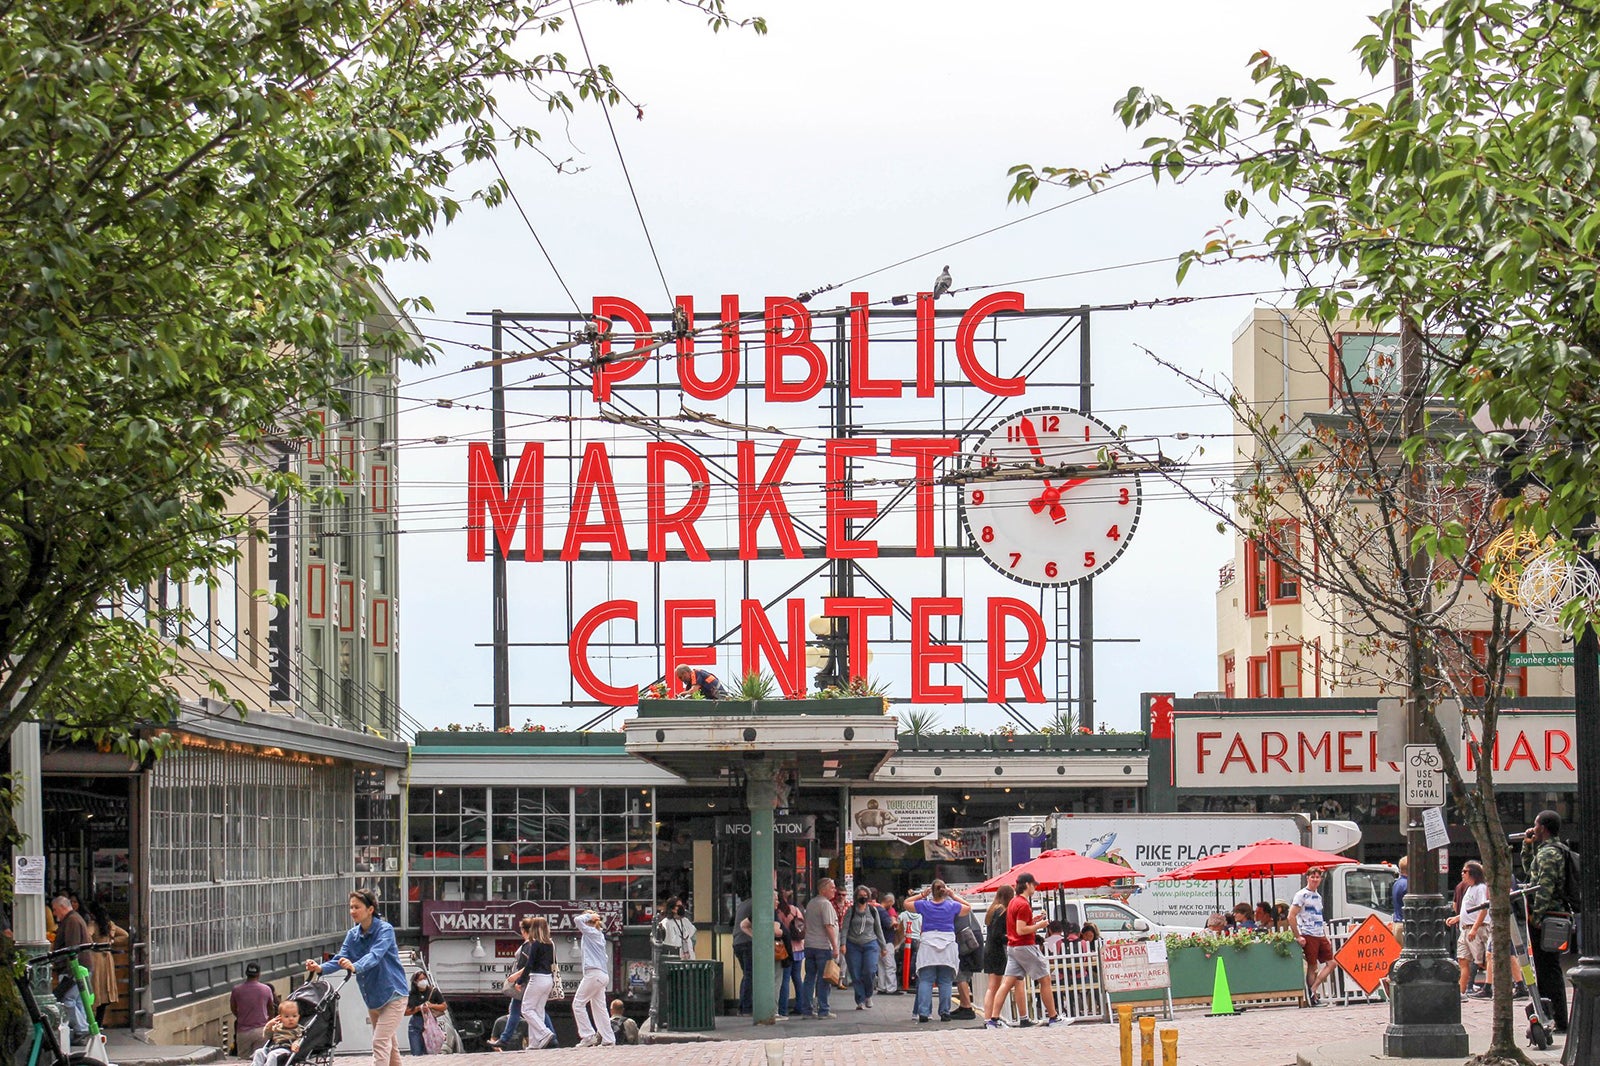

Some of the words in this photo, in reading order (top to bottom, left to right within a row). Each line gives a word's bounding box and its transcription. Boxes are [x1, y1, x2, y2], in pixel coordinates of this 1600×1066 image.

[592, 291, 1027, 403] PUBLIC
[1041, 415, 1060, 433] 12
[1007, 425, 1021, 443] 11
[1084, 425, 1090, 442] 1
[467, 437, 960, 562] MARKET
[971, 489, 985, 506] 9
[1118, 487, 1129, 505] 3
[981, 525, 995, 543] 8
[1106, 524, 1121, 541] 4
[1009, 552, 1022, 568] 7
[1083, 551, 1096, 568] 5
[1044, 561, 1058, 578] 6
[568, 596, 1048, 707] CENTER
[1515, 656, 1545, 665] pioneer
[1416, 769, 1432, 778] USE
[1417, 780, 1433, 788] PED
[1410, 789, 1439, 798] SIGNAL
[886, 800, 906, 810] YOUR
[907, 800, 935, 809] CHANGE
[725, 823, 803, 834] INFOATION
[951, 847, 987, 858] Salmo
[1135, 845, 1172, 860] PIKE
[439, 913, 516, 930] MARKET
[1358, 933, 1385, 945] ROAD
[1103, 947, 1118, 960] NO
[1122, 945, 1147, 956] PARK
[1357, 947, 1385, 958] WORK
[1353, 961, 1388, 973] AHEAD
[1106, 971, 1143, 981] TOW-AWAY
